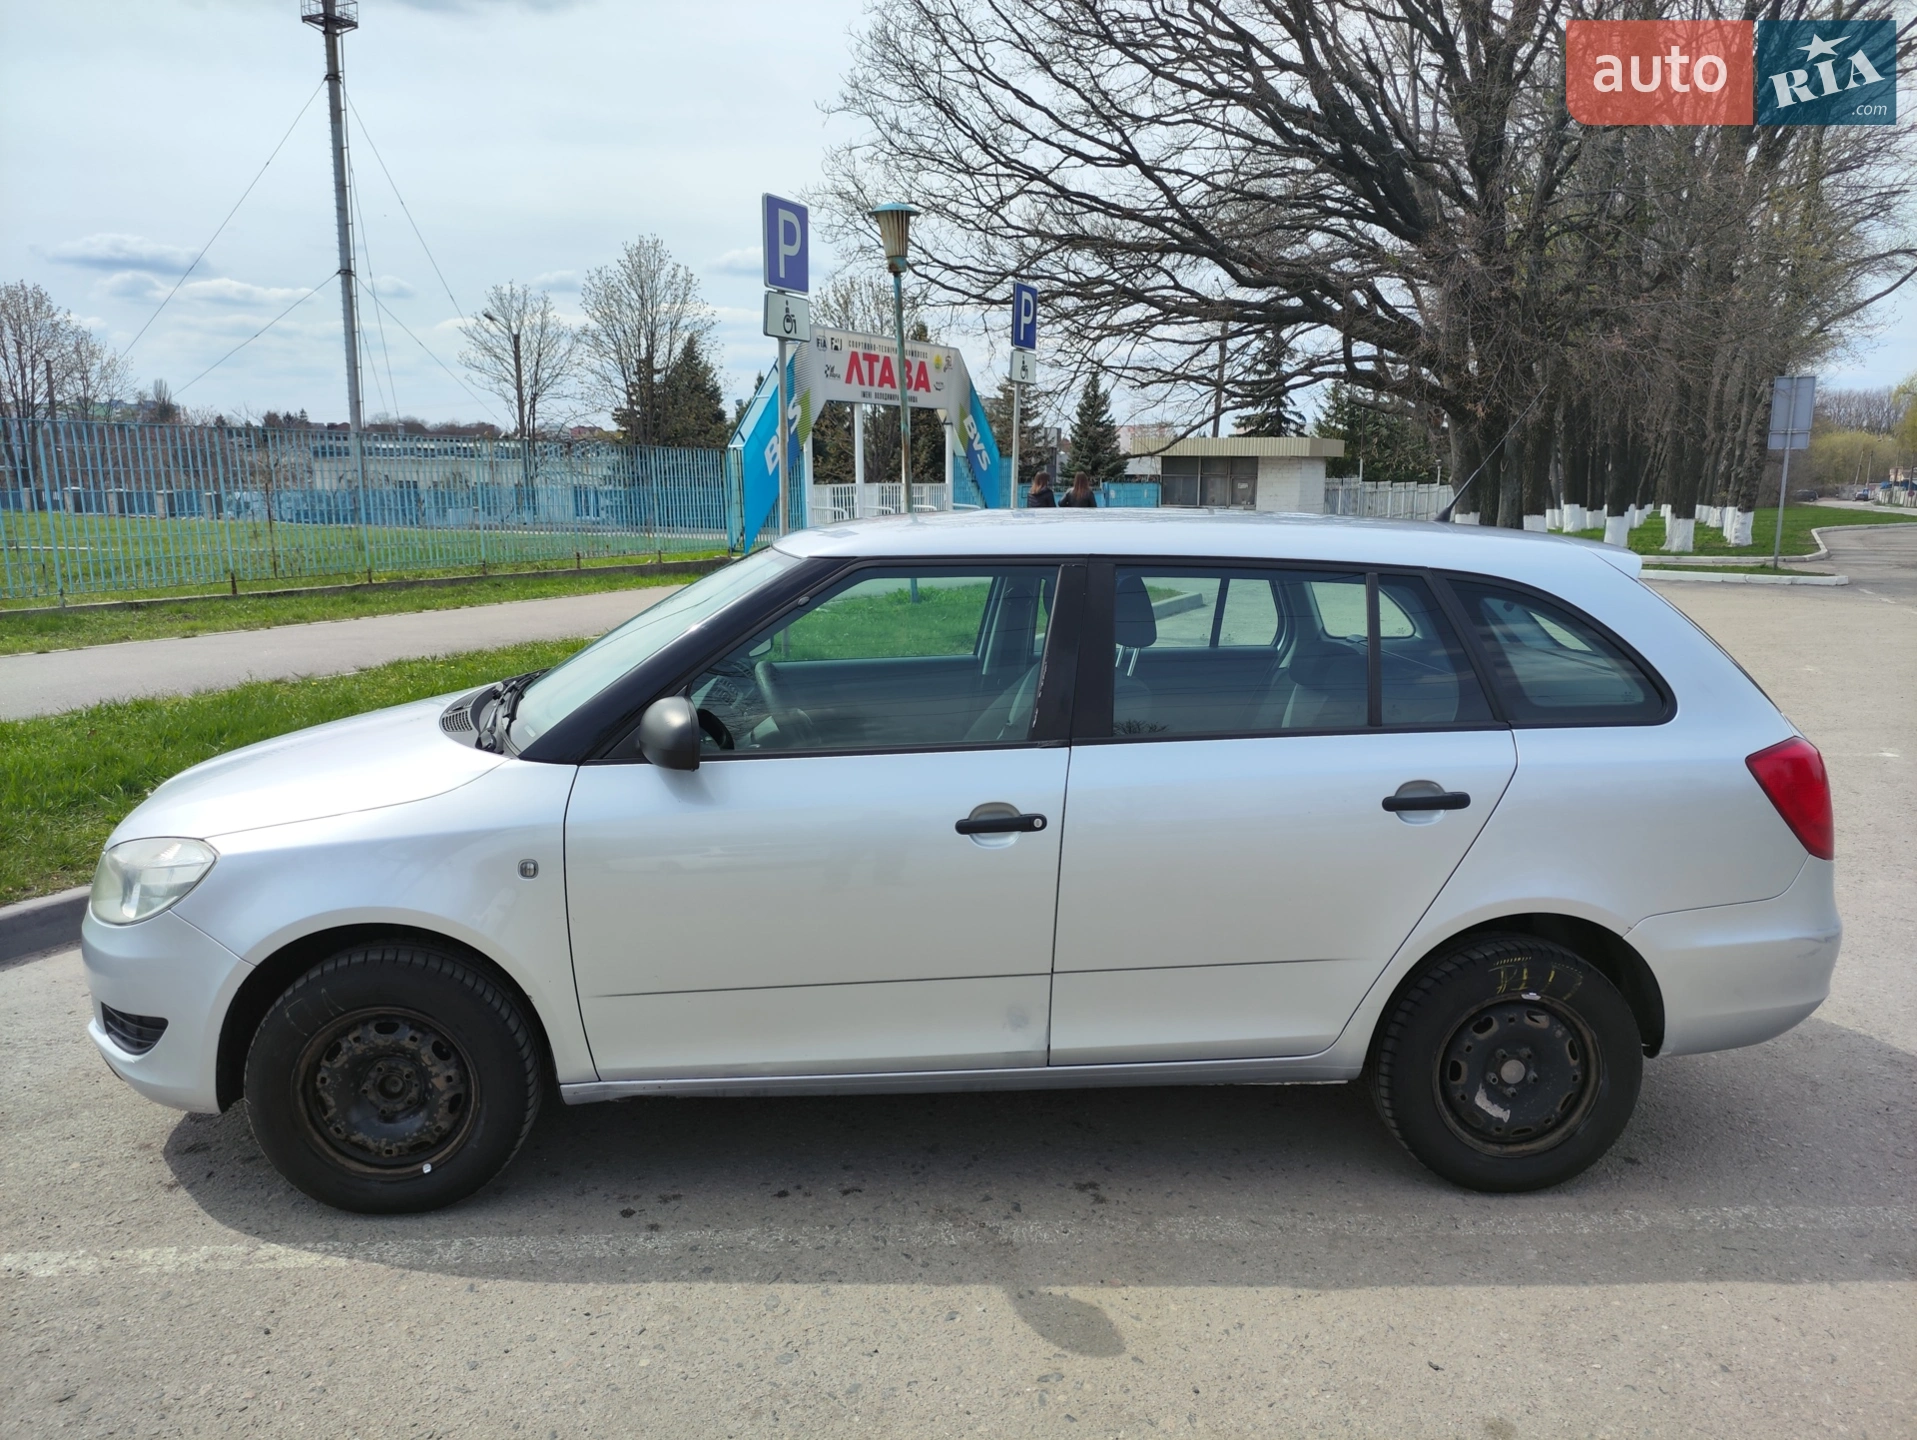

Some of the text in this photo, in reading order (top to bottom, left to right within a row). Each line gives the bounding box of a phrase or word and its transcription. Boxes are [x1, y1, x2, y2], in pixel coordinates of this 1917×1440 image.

[777, 208, 802, 279] P
[1020, 290, 1034, 341] P
[763, 394, 802, 476] BS
[963, 414, 991, 472] BVS
